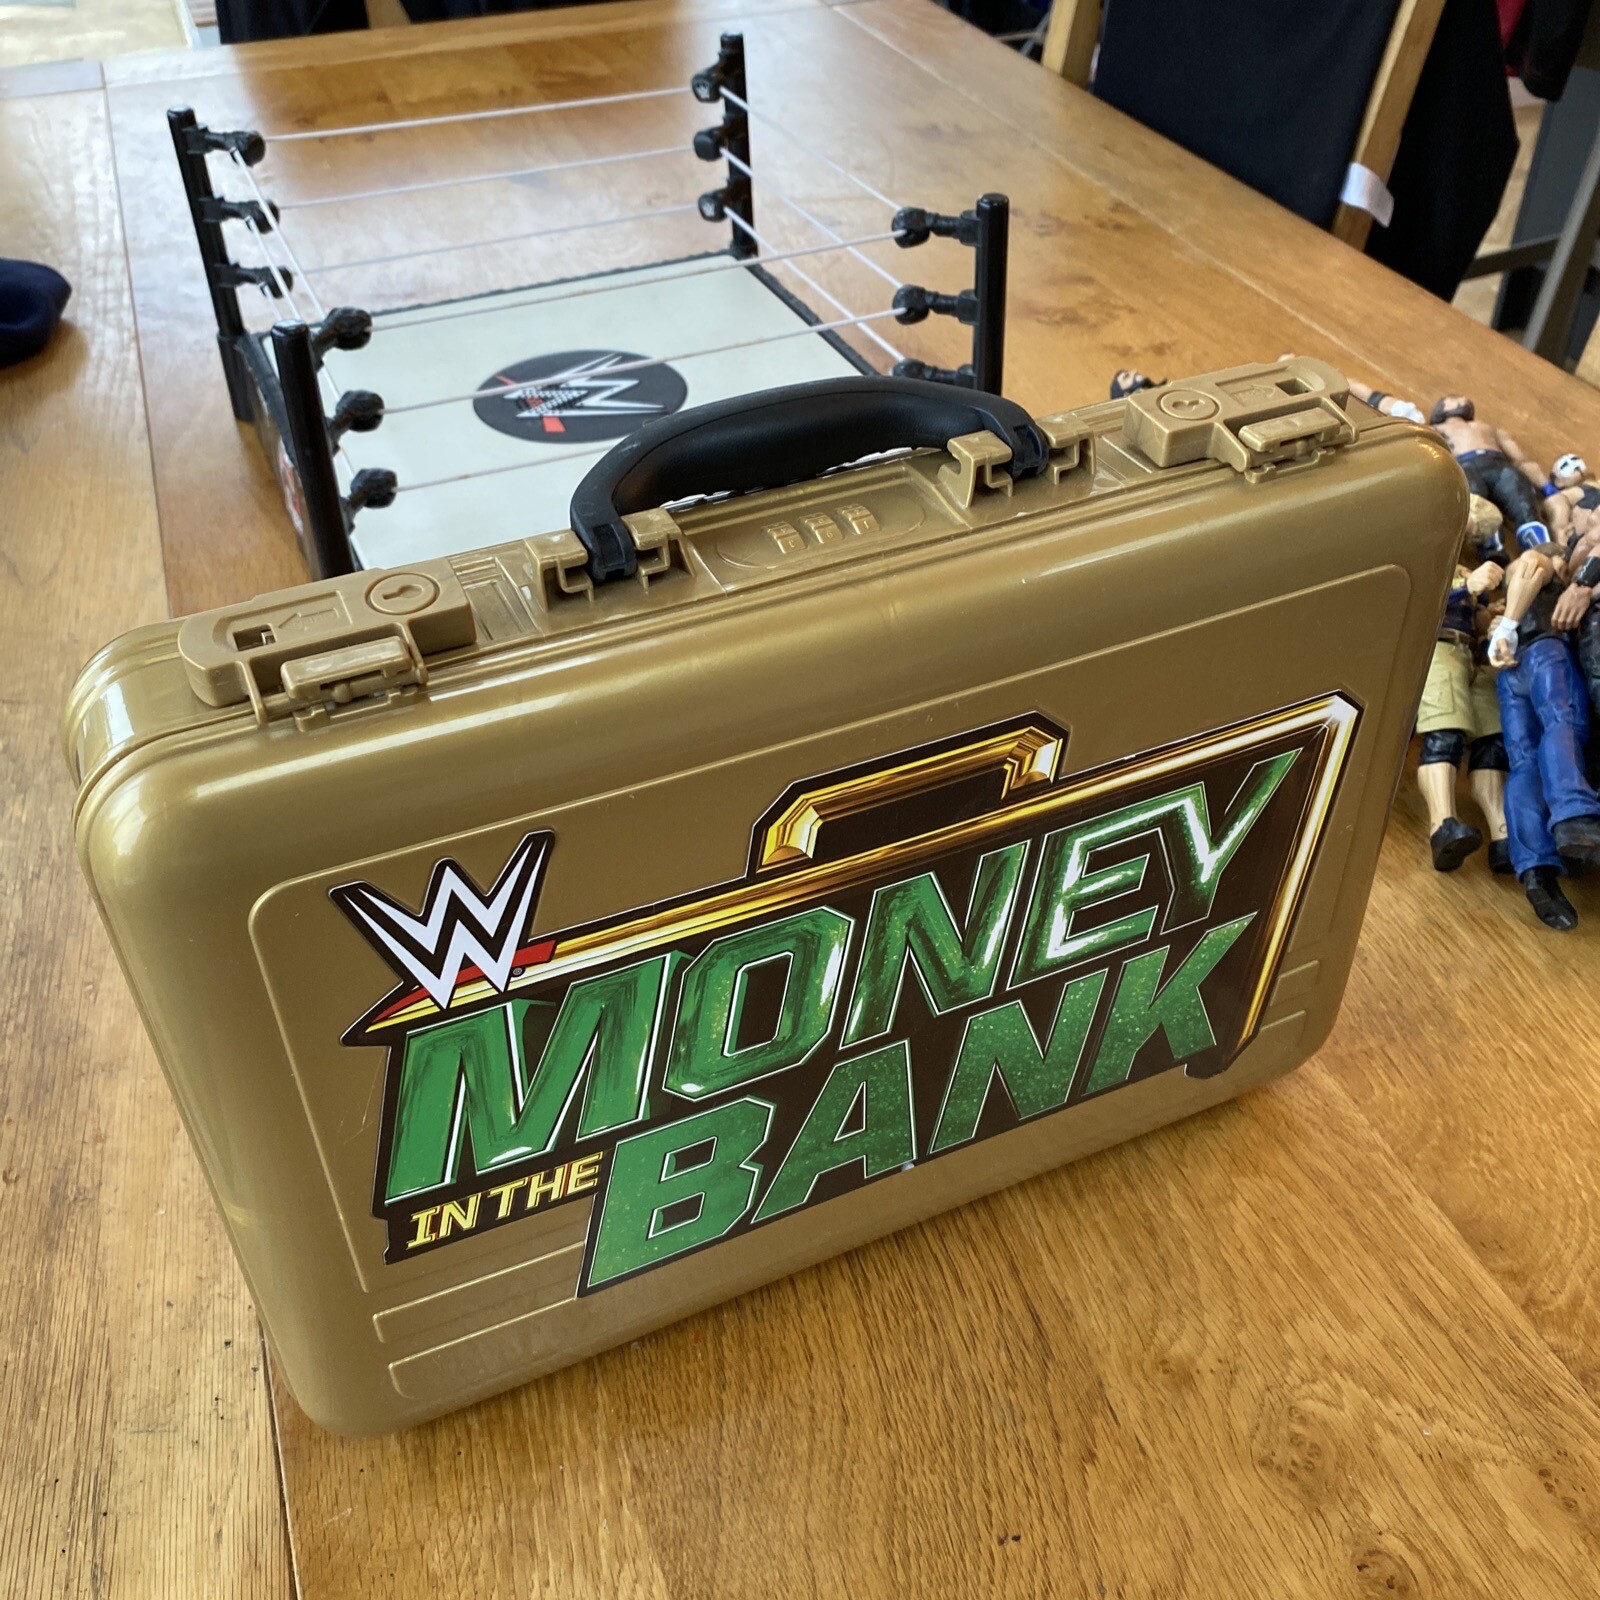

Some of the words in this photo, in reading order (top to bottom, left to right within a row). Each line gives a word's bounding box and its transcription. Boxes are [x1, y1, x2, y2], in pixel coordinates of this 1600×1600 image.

[384, 747, 1304, 1207] MONEY
[588, 911, 1258, 1288] BANK
[406, 1192, 482, 1250] IN
[487, 1151, 603, 1220] THE
